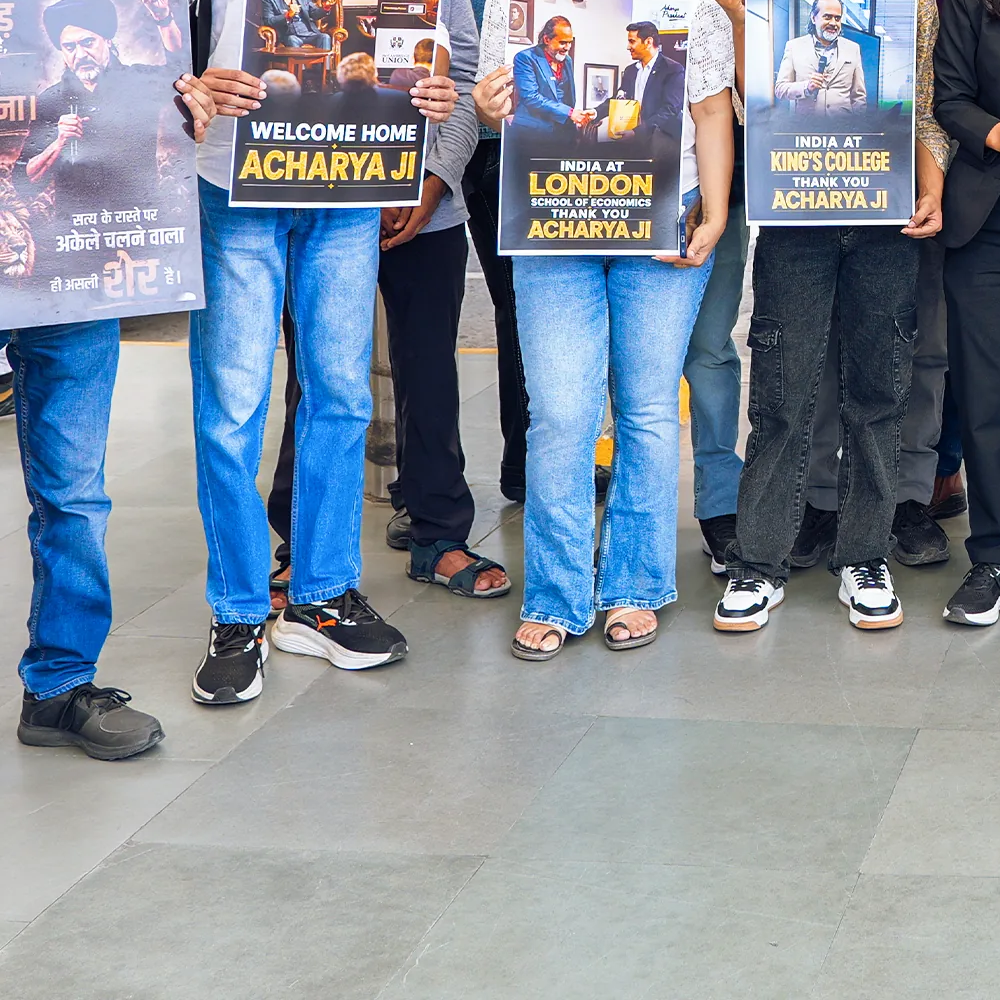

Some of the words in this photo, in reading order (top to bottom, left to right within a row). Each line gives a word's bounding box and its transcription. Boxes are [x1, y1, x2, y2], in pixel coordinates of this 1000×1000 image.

[381, 56, 410, 64] UNION
[251, 121, 357, 142] WELCOME
[361, 123, 418, 142] HOME
[795, 135, 838, 149] INDIA
[843, 135, 862, 149] AT
[238, 149, 386, 181] ACHARYA
[390, 151, 417, 180] JI
[560, 160, 602, 172] INDIA
[605, 161, 624, 172] AT
[770, 151, 822, 172] KING'S
[824, 151, 891, 172] COLLEGE
[529, 172, 653, 196] LONDON
[792, 176, 839, 188] THANK
[842, 176, 870, 188] YOU
[530, 198, 573, 207] SCHOOL
[575, 198, 590, 207] OF
[590, 198, 652, 207] ECONOMICS
[771, 190, 868, 209] ACHARYA
[870, 190, 888, 209] JI
[72, 212, 97, 226] सत्य
[100, 209, 112, 224] के
[114, 207, 141, 223] रास्ते
[143, 209, 158, 222] पर
[551, 208, 597, 219] THANK
[602, 209, 629, 219] YOU
[55, 228, 102, 252] अकेले
[103, 225, 147, 249] चलने
[148, 227, 186, 245] वाला
[527, 220, 630, 239] ACHARYA
[631, 220, 652, 239] JI
[49, 276, 62, 292] ही
[65, 273, 99, 291] असली
[102, 250, 160, 299] शेर
